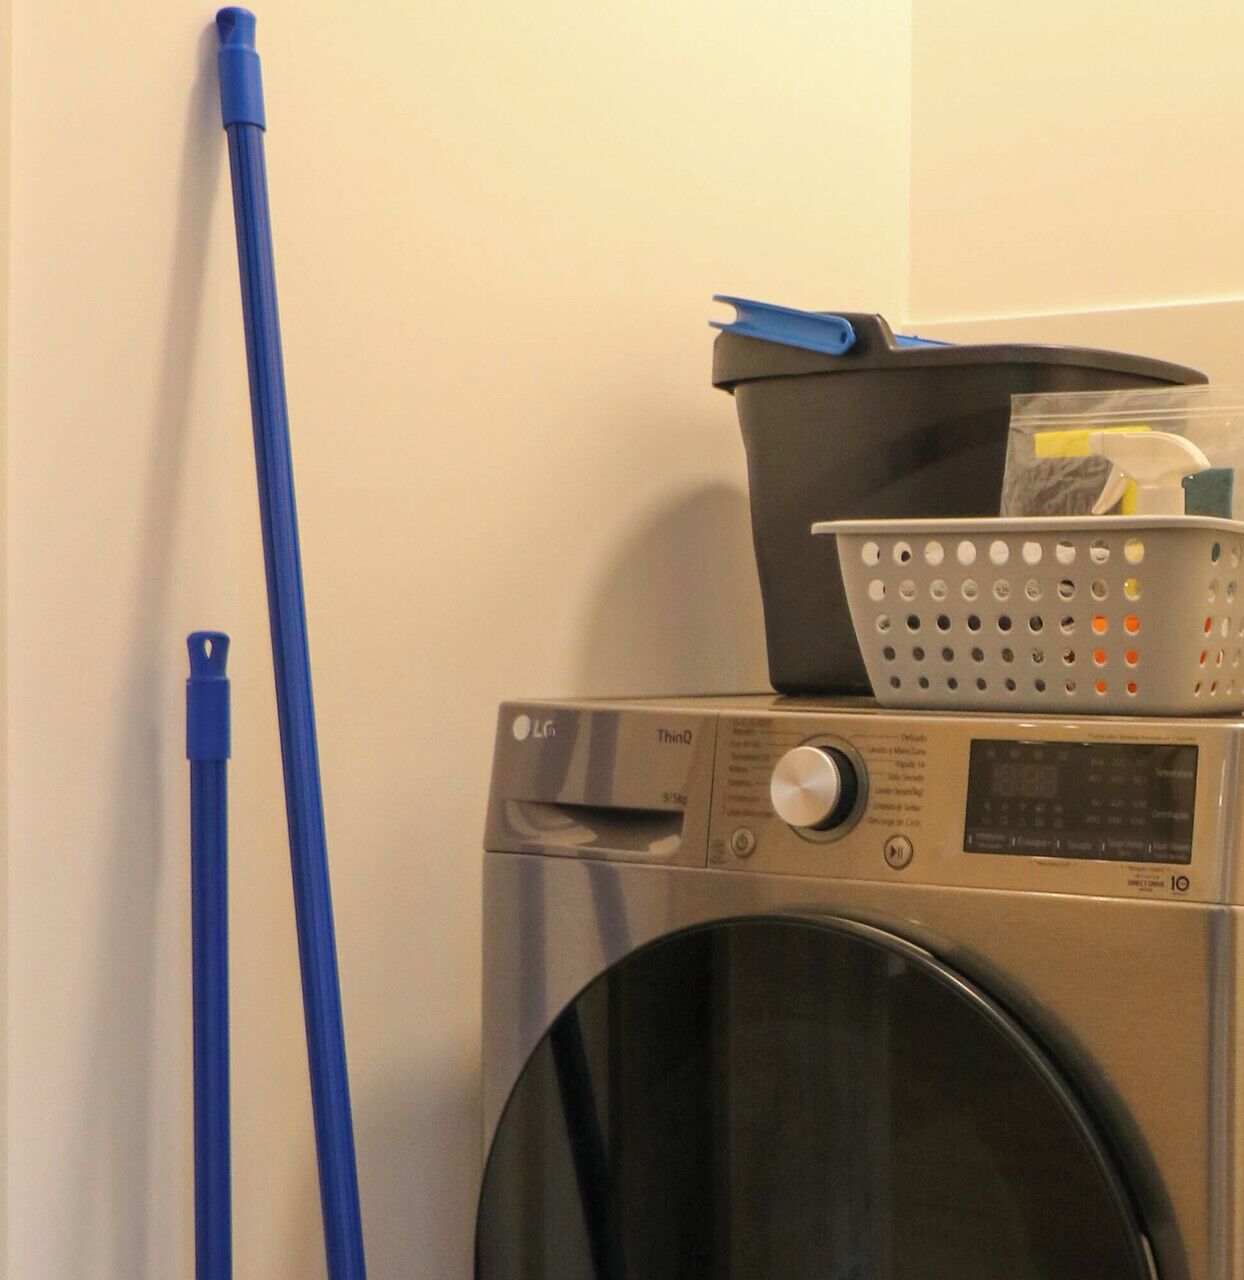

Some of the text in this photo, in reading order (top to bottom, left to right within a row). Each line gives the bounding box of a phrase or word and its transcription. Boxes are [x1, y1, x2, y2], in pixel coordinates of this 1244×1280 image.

[533, 720, 556, 739] LG
[657, 728, 692, 745] ThinQ
[1170, 875, 1190, 892] 10
